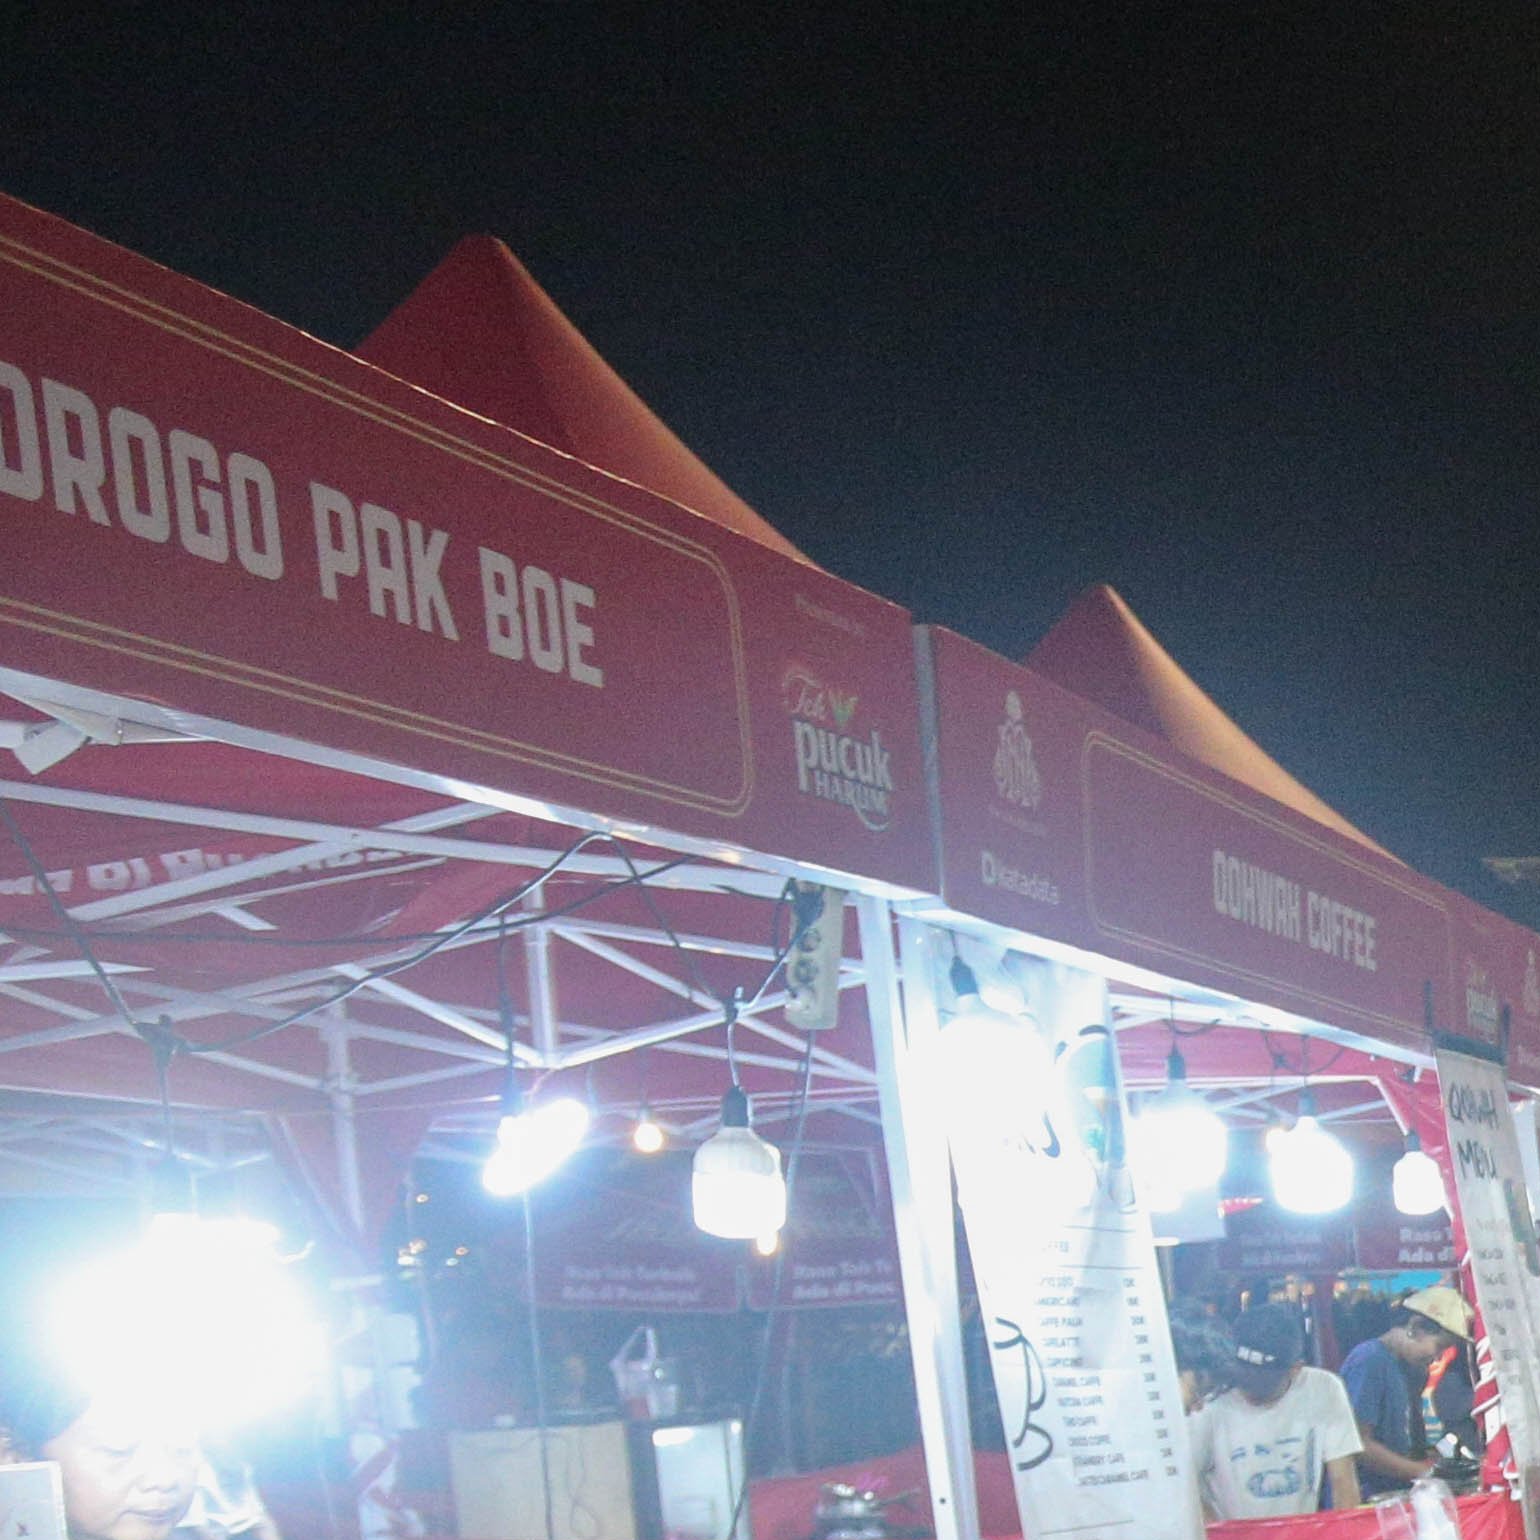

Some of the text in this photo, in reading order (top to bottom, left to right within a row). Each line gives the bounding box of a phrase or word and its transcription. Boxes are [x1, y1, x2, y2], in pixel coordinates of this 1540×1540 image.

[310, 482, 460, 642] PAK
[479, 546, 604, 689] BOE
[793, 718, 893, 793] pucuk
[1306, 891, 1378, 972] COFFEE
